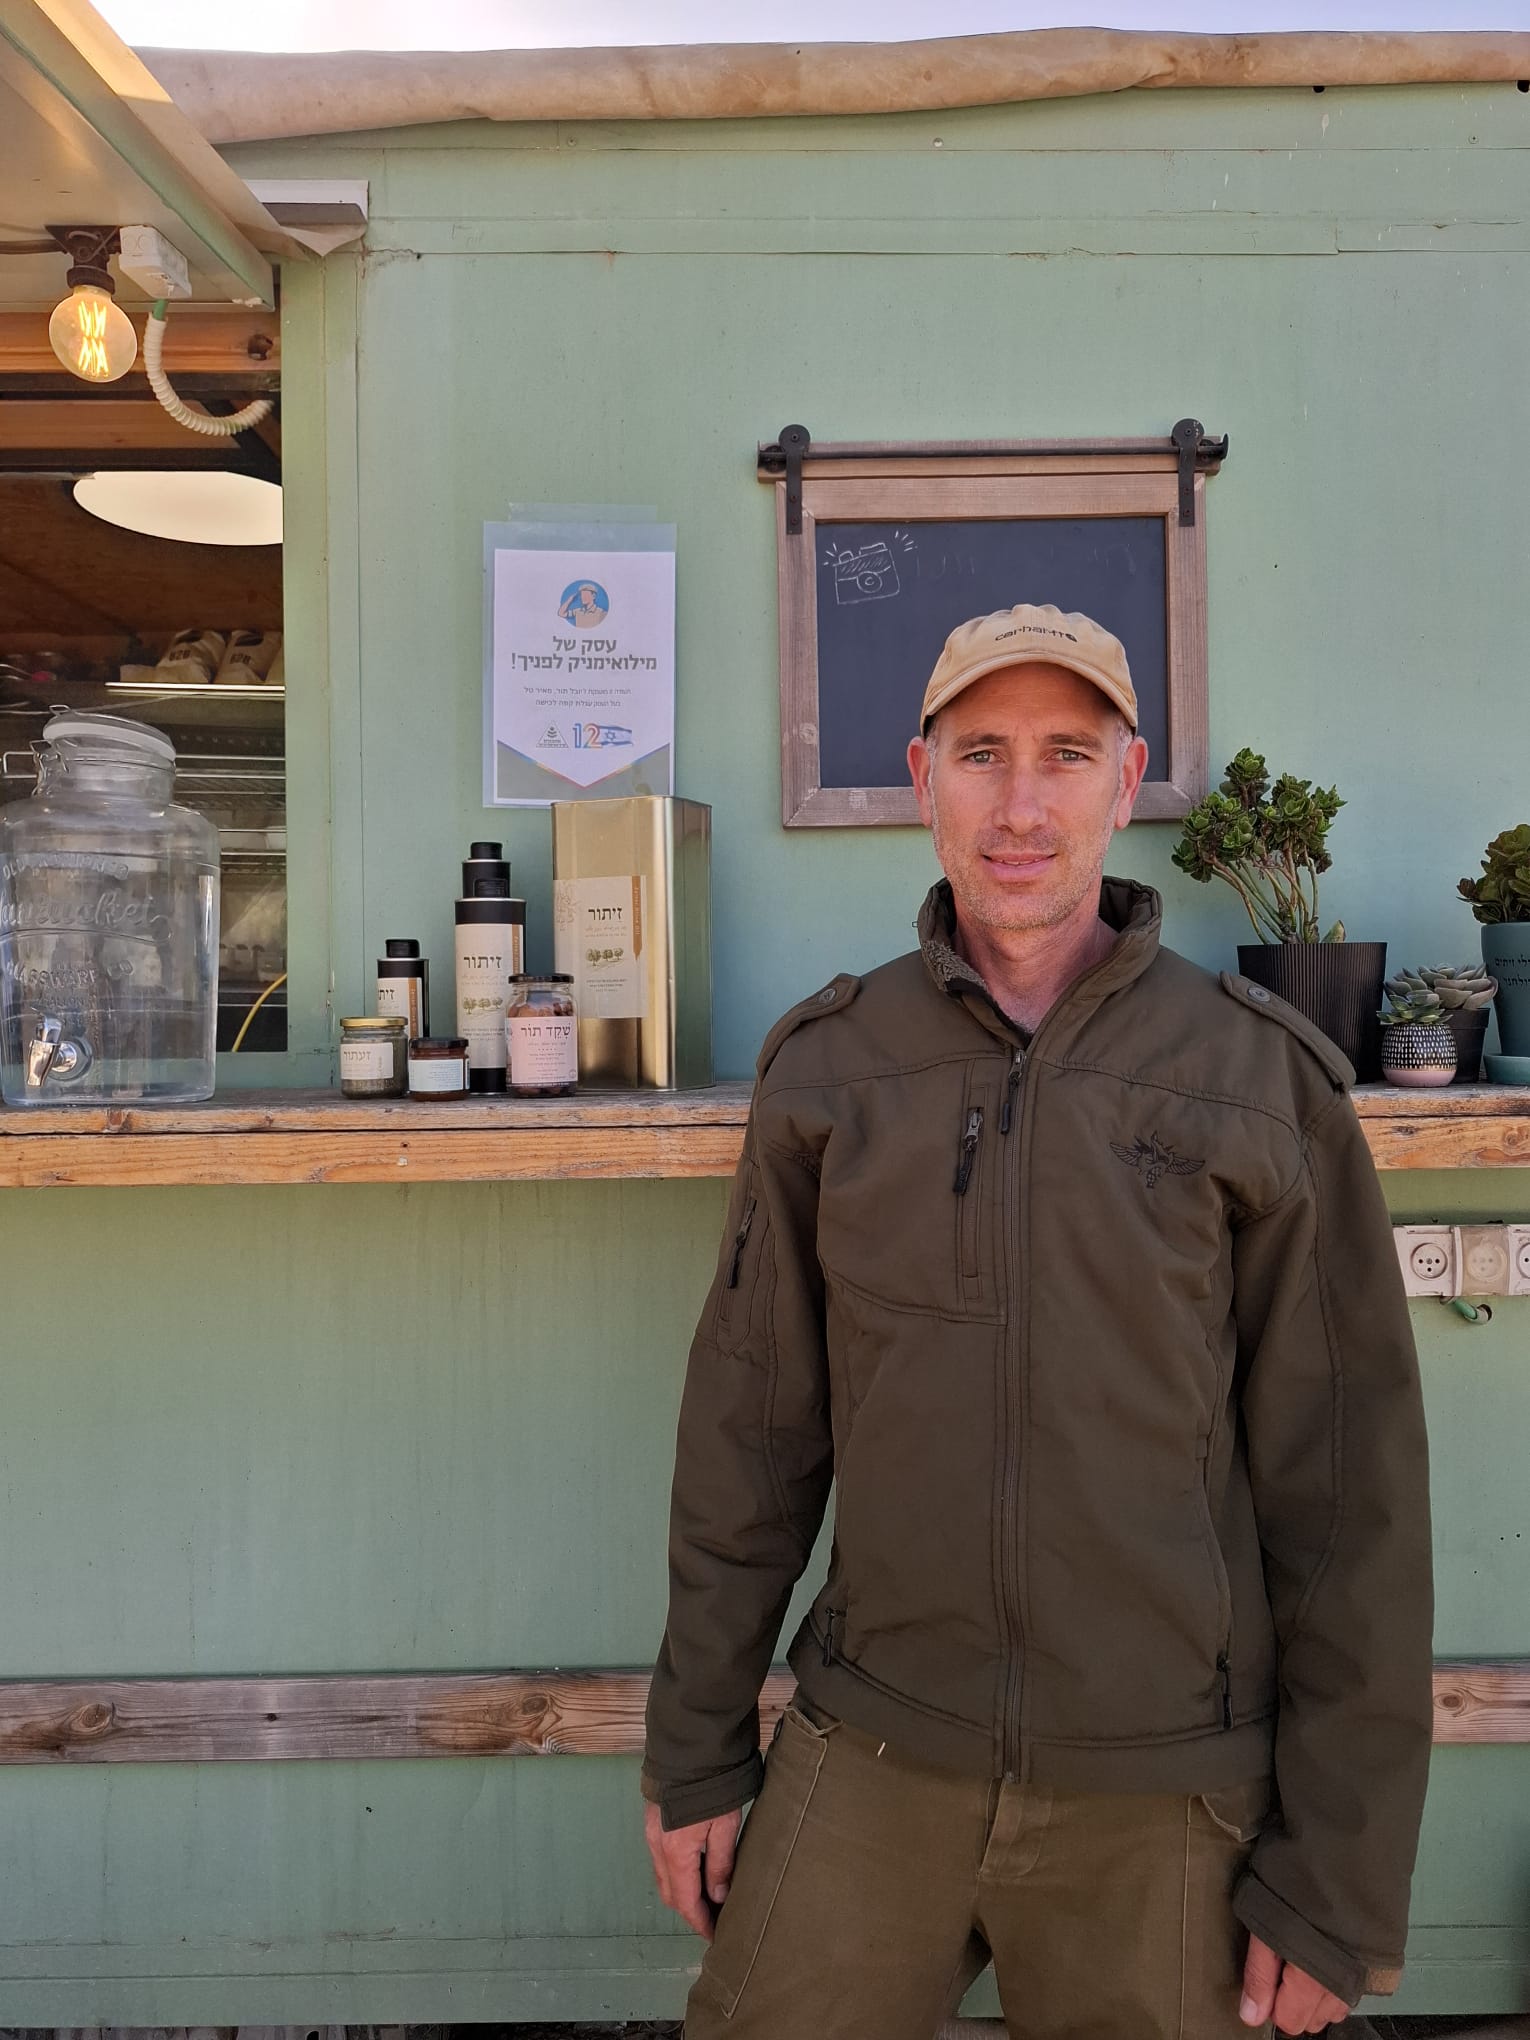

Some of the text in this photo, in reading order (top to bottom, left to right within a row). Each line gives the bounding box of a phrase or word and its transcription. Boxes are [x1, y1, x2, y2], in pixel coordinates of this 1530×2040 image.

[553, 635, 617, 655] עסק של
[511, 653, 657, 673] מילואימניק לפניך!
[572, 723, 603, 749] 12
[588, 907, 623, 921] זיתור
[463, 956, 502, 969] זיתור
